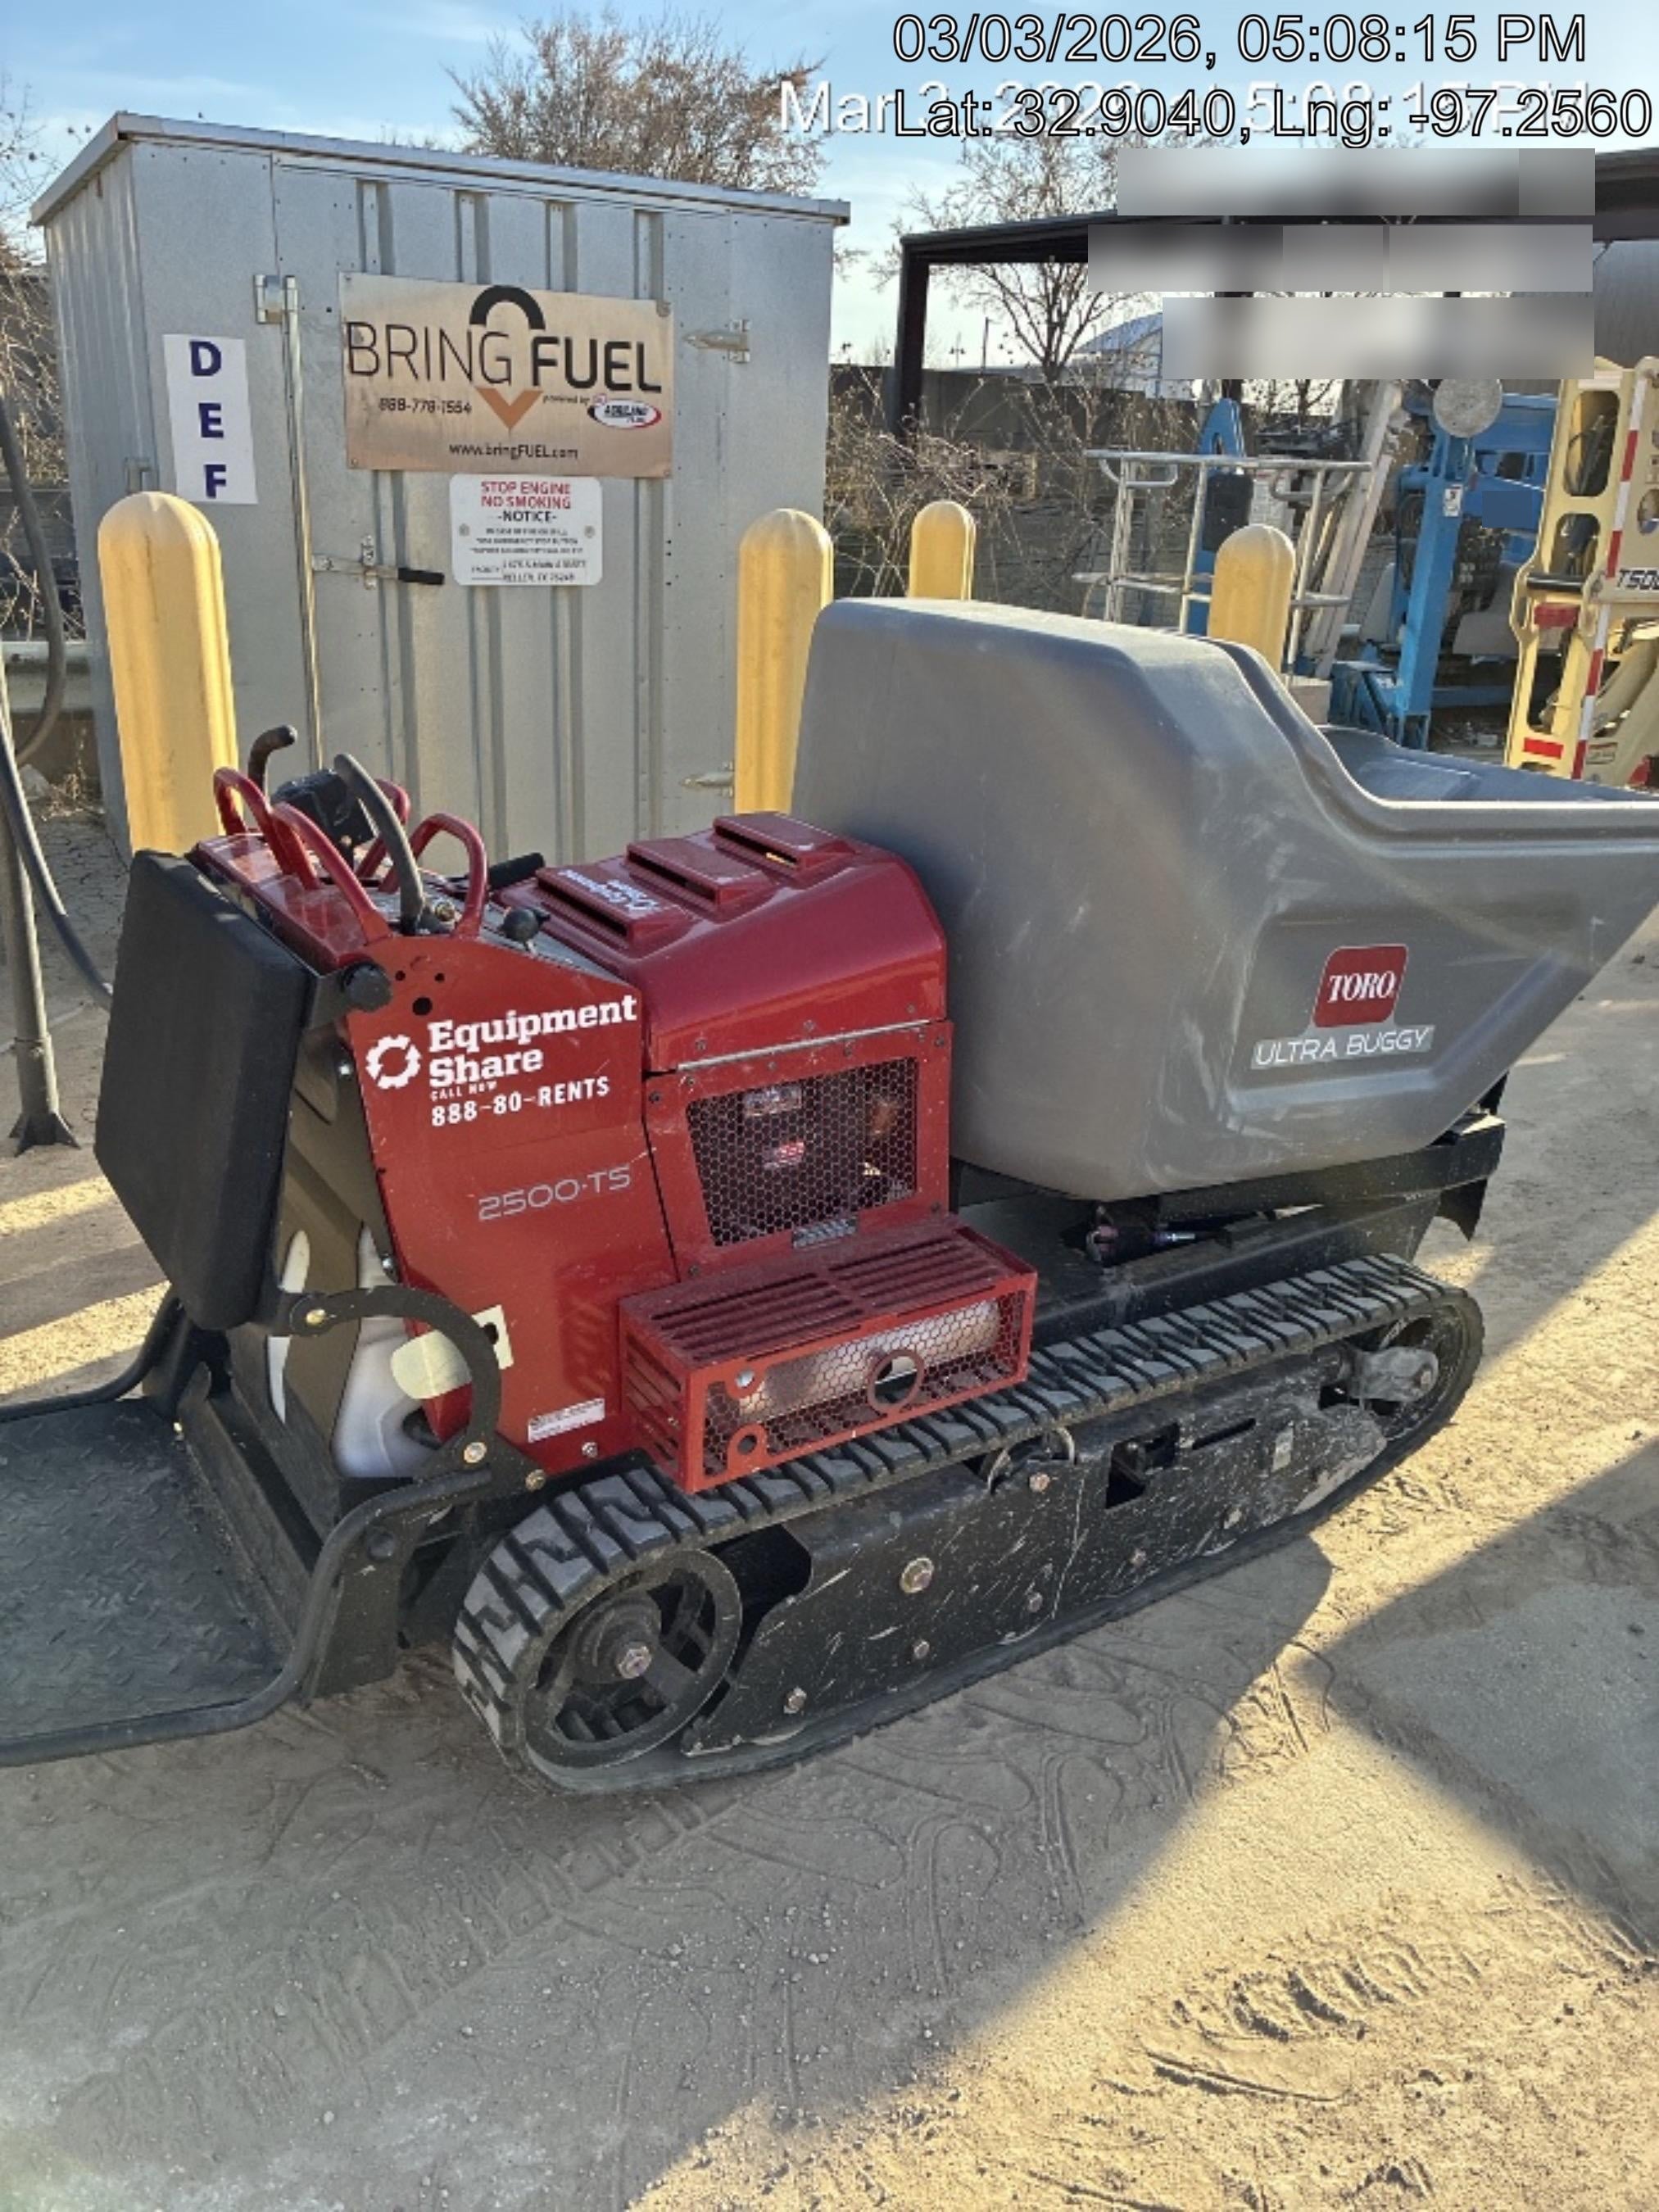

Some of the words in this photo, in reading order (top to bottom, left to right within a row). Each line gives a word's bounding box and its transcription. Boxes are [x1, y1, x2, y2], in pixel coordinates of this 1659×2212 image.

[345, 320, 513, 387] BRING
[531, 335, 662, 394] FUEL
[189, 341, 227, 499] DEF
[449, 442, 578, 460] www.bringFUEL.com
[481, 481, 517, 493] STOP
[520, 482, 571, 495] ENGINE
[481, 496, 502, 507] NO
[505, 496, 571, 510] SMOKING
[1327, 970, 1397, 1003] TORO
[428, 995, 637, 1053] Equipment
[1255, 1037, 1338, 1066] ULTRA
[1346, 1027, 1431, 1056] BUGGY
[428, 1049, 544, 1087] Share
[431, 1076, 610, 1127] 888-80-RENTS
[432, 1086, 463, 1101] CALL
